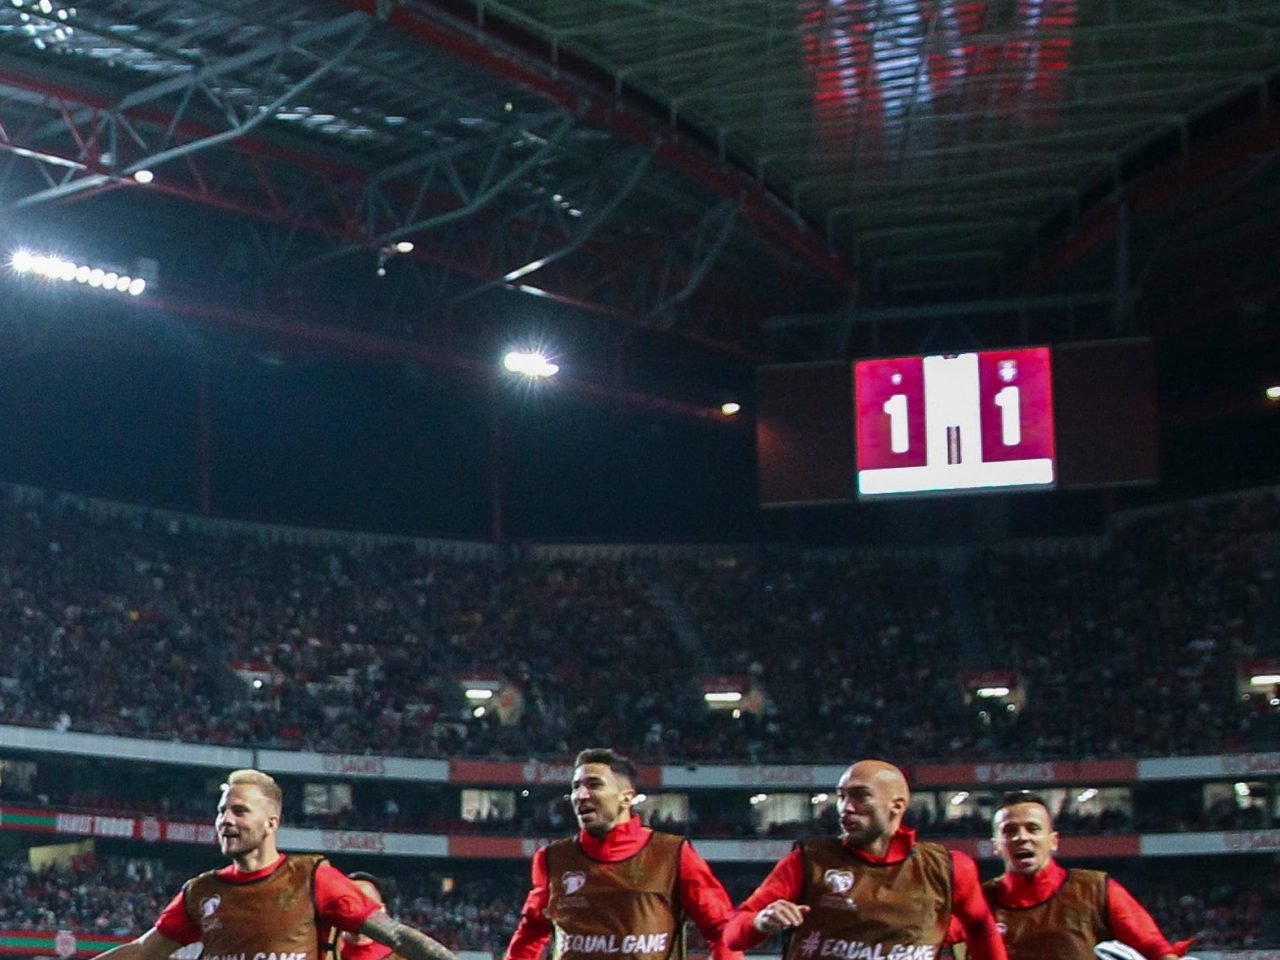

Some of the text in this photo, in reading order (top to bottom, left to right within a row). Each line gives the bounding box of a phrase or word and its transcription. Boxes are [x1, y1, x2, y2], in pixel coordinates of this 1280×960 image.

[883, 394, 910, 454] 1
[994, 386, 1021, 446] 1
[621, 933, 668, 954] GAME
